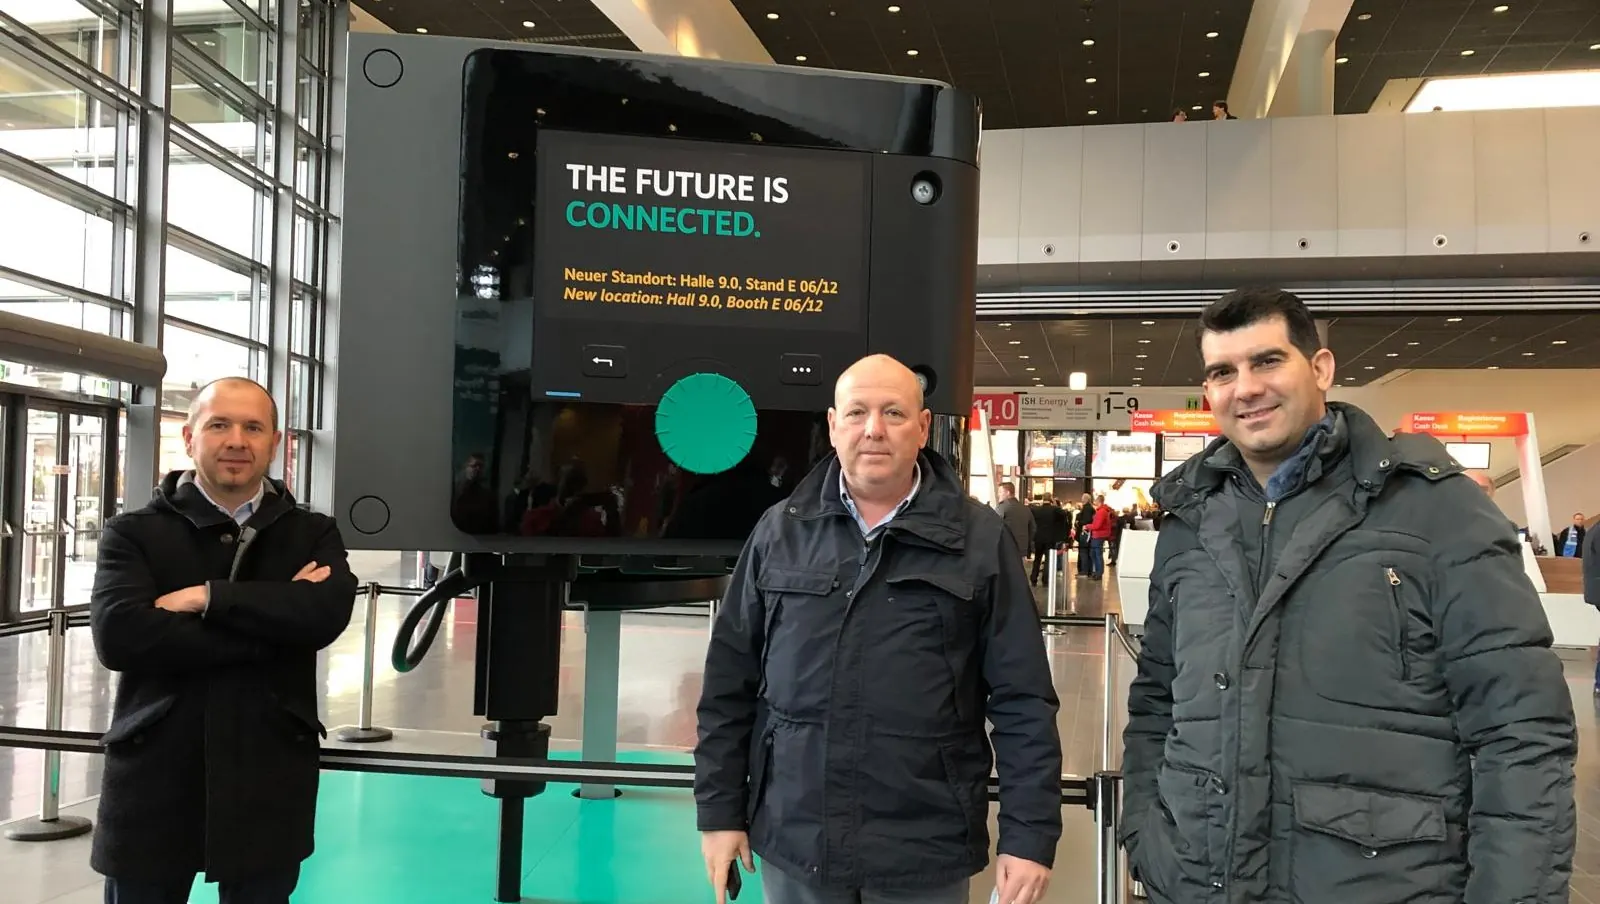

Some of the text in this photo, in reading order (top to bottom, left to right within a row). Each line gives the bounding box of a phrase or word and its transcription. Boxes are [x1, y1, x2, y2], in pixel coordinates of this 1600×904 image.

[565, 163, 789, 204] THE FUTURE IS
[566, 200, 762, 238] CONNECTED.
[564, 267, 838, 296] Neuer Standort: Halle 9.0, Stand E 06/12
[563, 286, 824, 314] New location: Hall 9.0, Booth E 06/12
[1021, 397, 1068, 406] ISH Energy
